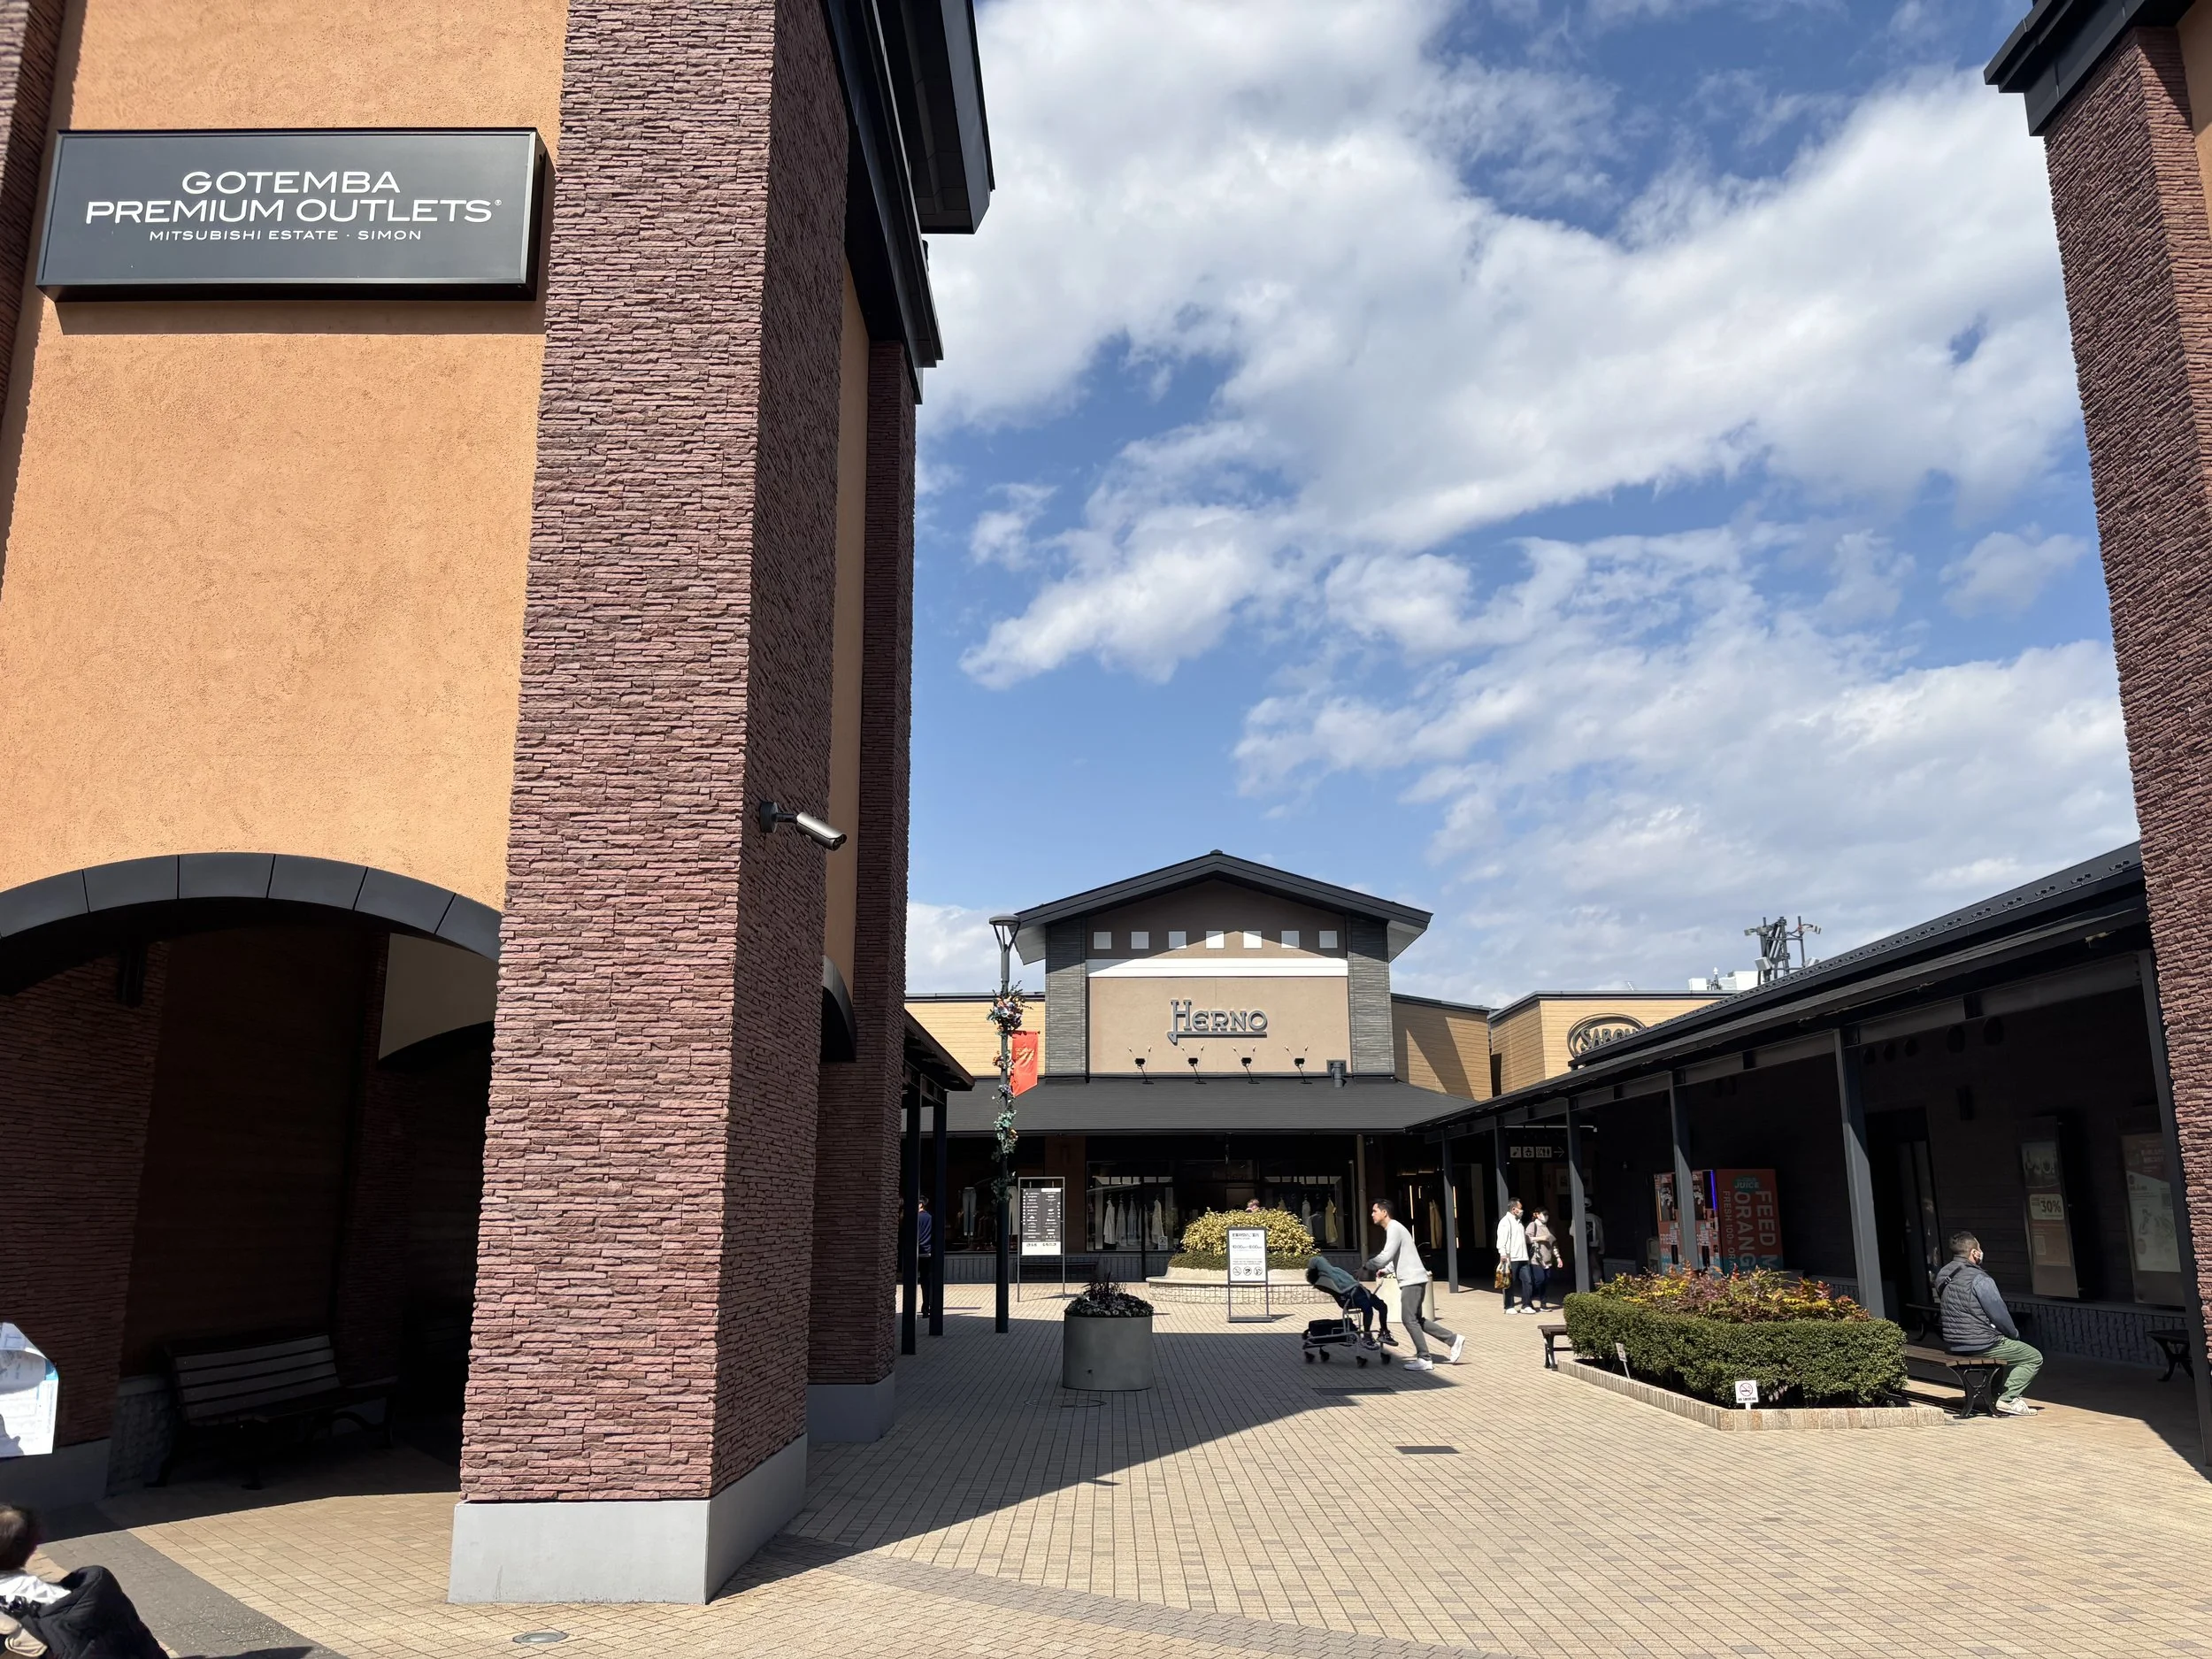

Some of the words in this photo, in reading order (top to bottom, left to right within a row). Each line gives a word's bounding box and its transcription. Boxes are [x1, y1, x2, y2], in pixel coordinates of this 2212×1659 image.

[181, 171, 401, 195] GOTEMBA
[86, 199, 285, 224] PREMIUM
[149, 230, 261, 241] MITSUBISHI
[268, 230, 339, 241] ESTATE
[357, 230, 421, 241] SIMON
[1723, 1190, 1733, 1221] FRESH
[2040, 1200, 2062, 1213] 30%
[1734, 1191, 1757, 1268] ORANG
[1755, 1190, 1777, 1247] FEED
